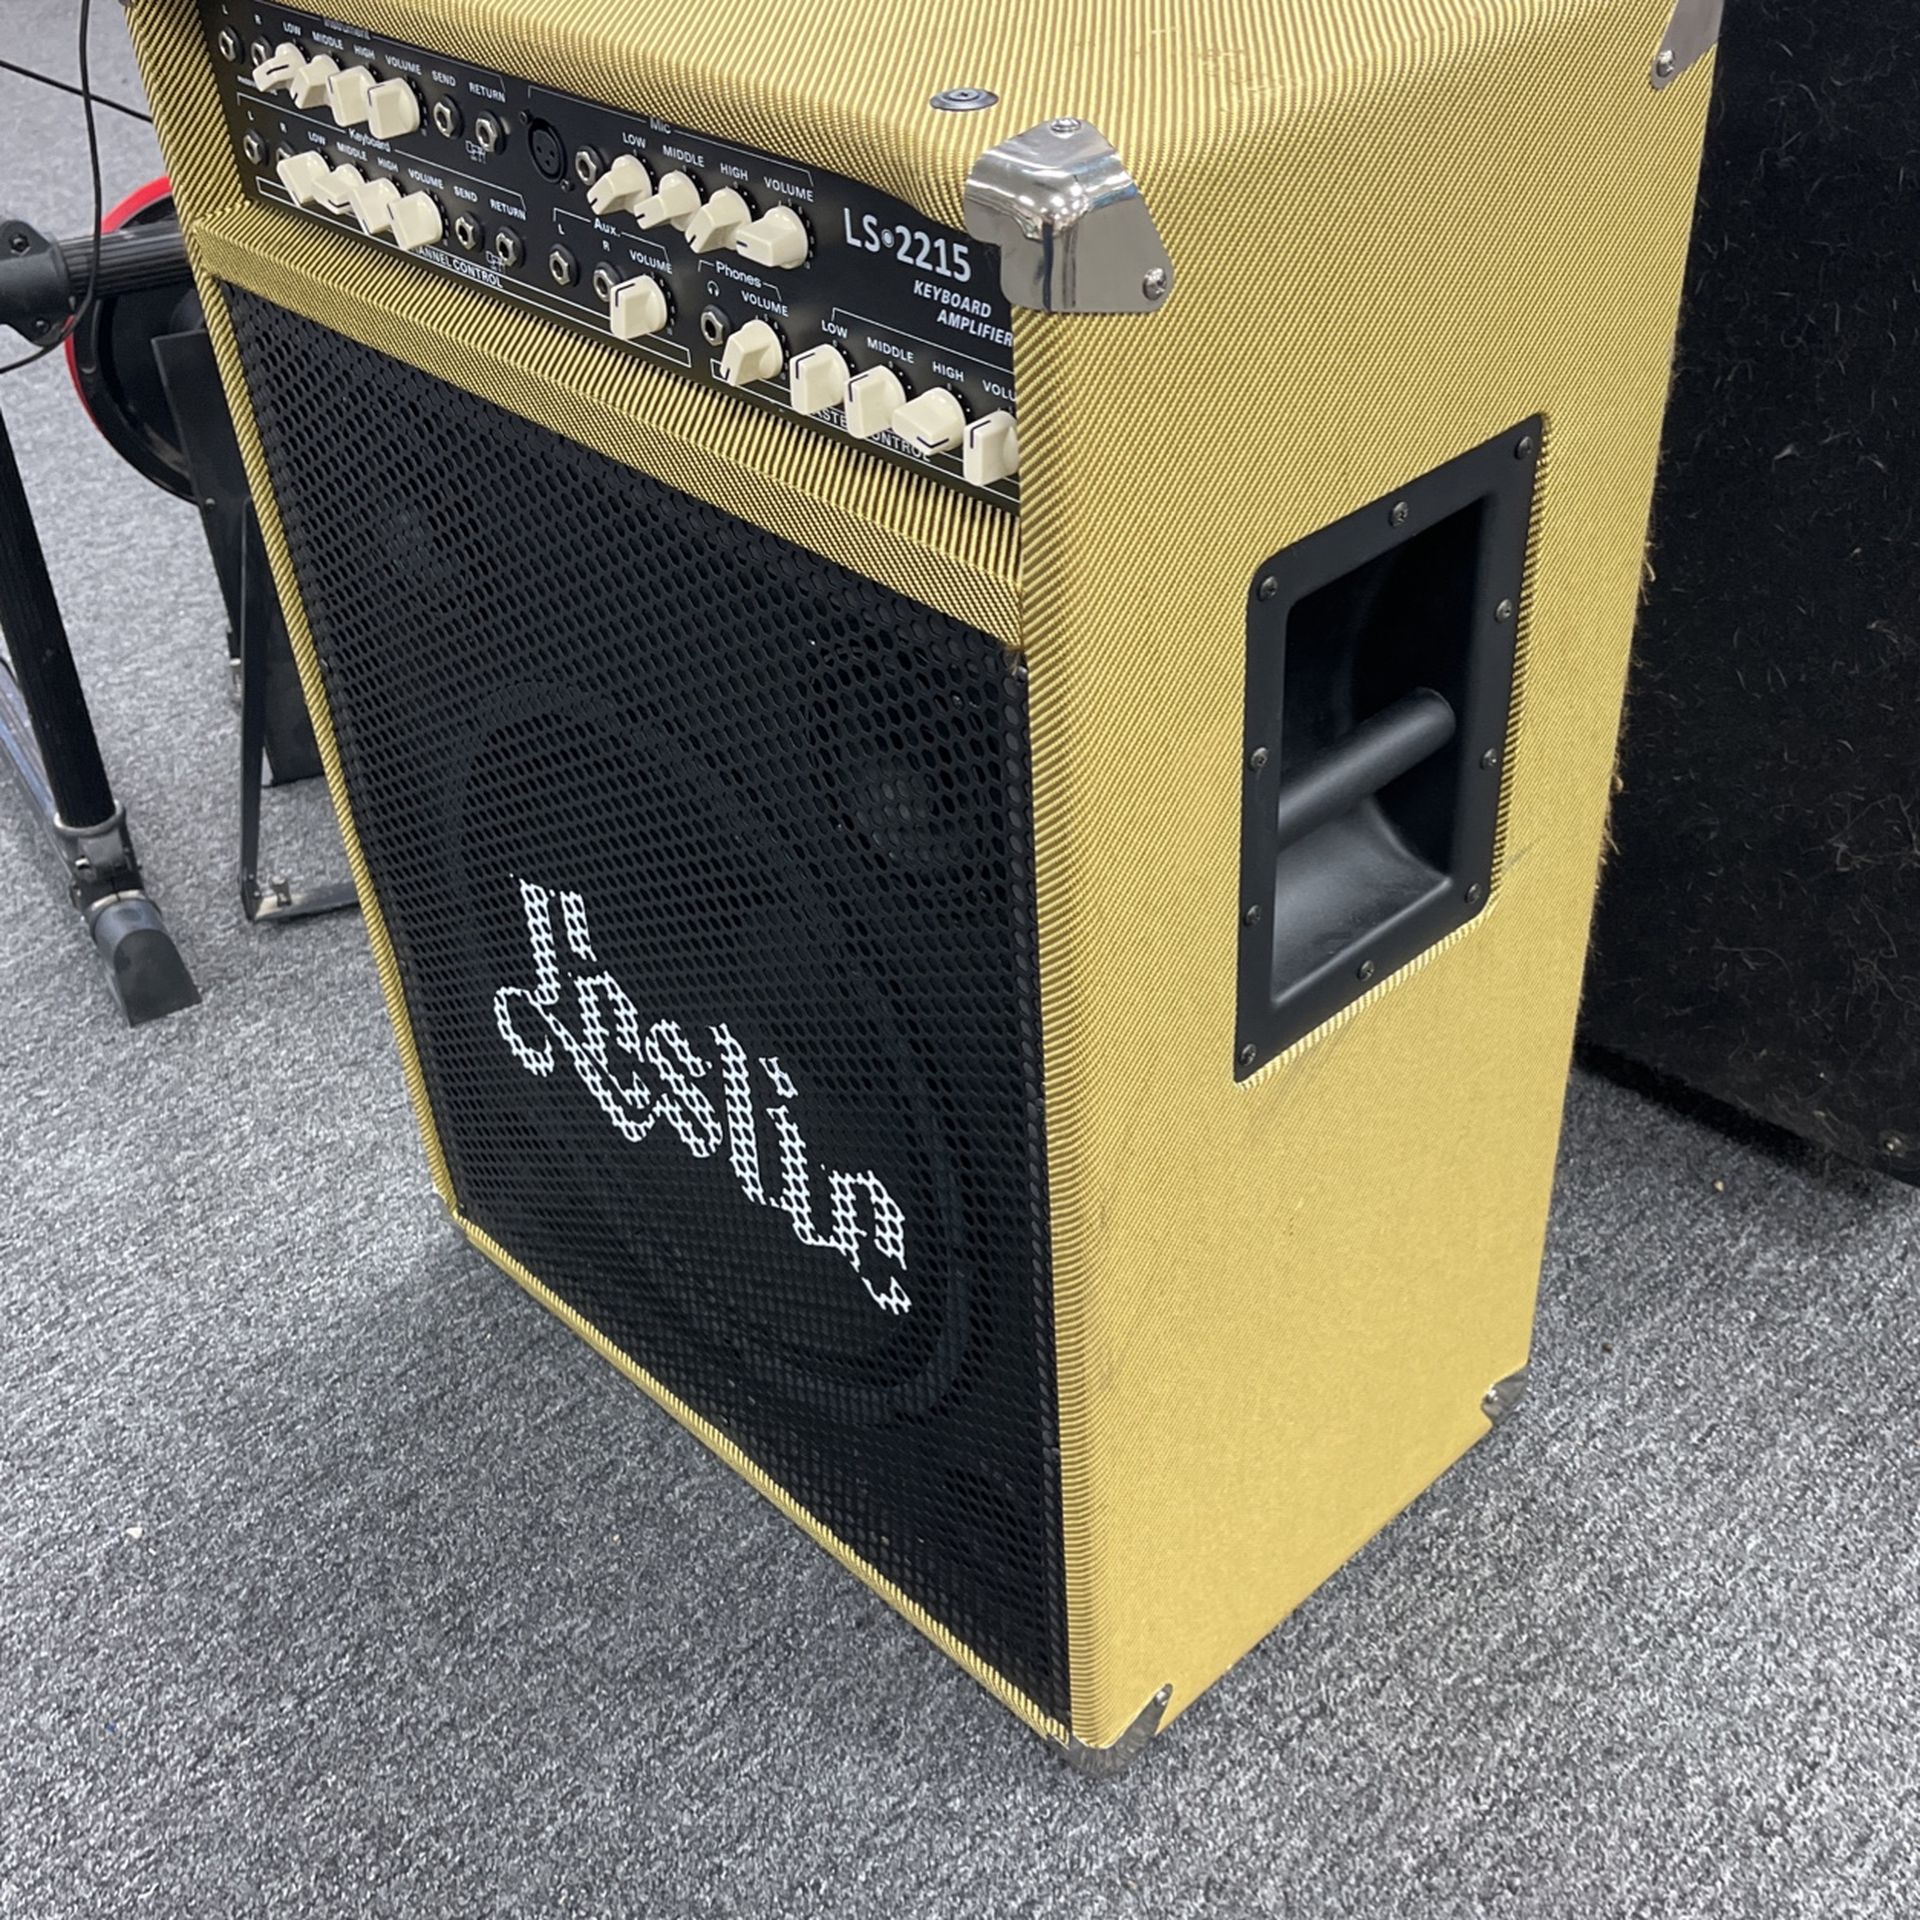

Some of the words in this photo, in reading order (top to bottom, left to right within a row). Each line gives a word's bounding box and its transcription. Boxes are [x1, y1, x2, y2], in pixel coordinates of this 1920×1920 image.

[282, 21, 302, 36] LOW
[311, 31, 344, 50] MIDDLE
[353, 44, 376, 60] HIGH
[385, 54, 422, 76] VOLUME
[431, 70, 456, 87] SEND
[468, 82, 506, 103] RETURN
[649, 118, 671, 135] Mic
[307, 131, 326, 145] LOW
[348, 128, 391, 152] Keyboard
[622, 132, 646, 148] LOW
[336, 142, 368, 161] MIDDLE
[663, 145, 705, 168] MIDDLE
[377, 157, 399, 172] HIGH
[720, 163, 749, 181] HIGH
[407, 168, 444, 189] VOLUME
[453, 185, 478, 202] SEND
[763, 176, 814, 203] VOLUME
[489, 198, 526, 221] RETURN
[602, 240, 610, 251] R
[629, 249, 673, 275] VOLUME
[452, 259, 503, 289] CONTROL
[715, 260, 762, 288] Phones
[741, 290, 789, 318] VOLUME
[913, 279, 992, 319] KEYBOARD
[821, 320, 848, 339] LOW
[936, 309, 1014, 348] AMPLIFIER
[866, 337, 915, 364] MIDDLE
[932, 361, 965, 383] HIGH
[493, 870, 912, 1317] Leslie
